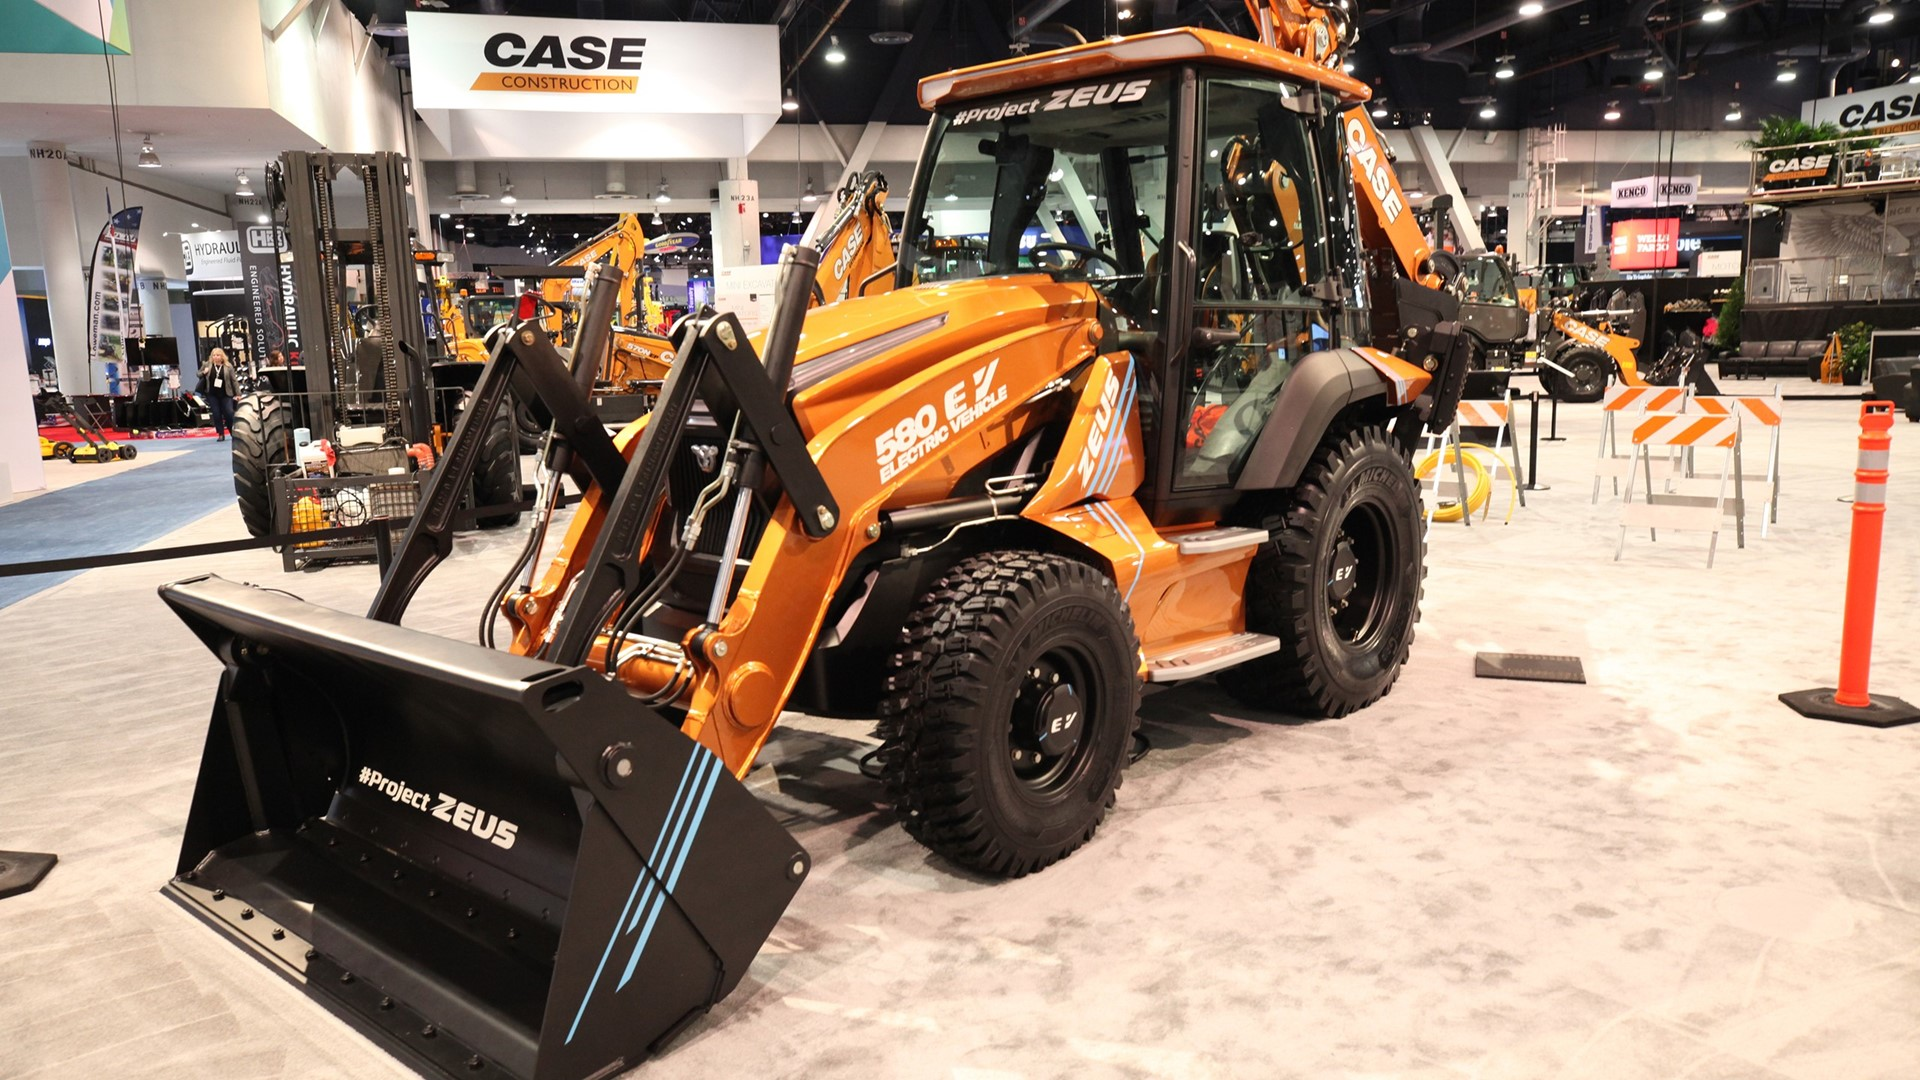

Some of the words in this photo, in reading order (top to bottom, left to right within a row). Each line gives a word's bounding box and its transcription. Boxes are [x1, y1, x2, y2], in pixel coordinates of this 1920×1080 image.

[483, 32, 647, 70] CASE
[501, 76, 633, 91] CONSTRUCTION
[952, 99, 1041, 126] #Project
[1041, 79, 1152, 111] ZEUS
[1347, 118, 1403, 225] CASE
[1769, 154, 1833, 173] CASE
[1618, 186, 1646, 199] KENCO
[1660, 183, 1691, 195] KENCO
[834, 221, 863, 280] CASE
[1636, 242, 1670, 253] FARGO
[1637, 234, 1670, 243] WELLS
[249, 265, 263, 325] ENGINEERED
[627, 343, 651, 356] 570N
[1564, 320, 1611, 348] CASE
[874, 403, 938, 466] 580
[879, 425, 949, 485] ELECTRIC
[949, 384, 1008, 434] VEHICLE
[1077, 367, 1120, 490] ZEUS
[358, 766, 431, 812] #Project
[429, 792, 519, 850] ZEUS
